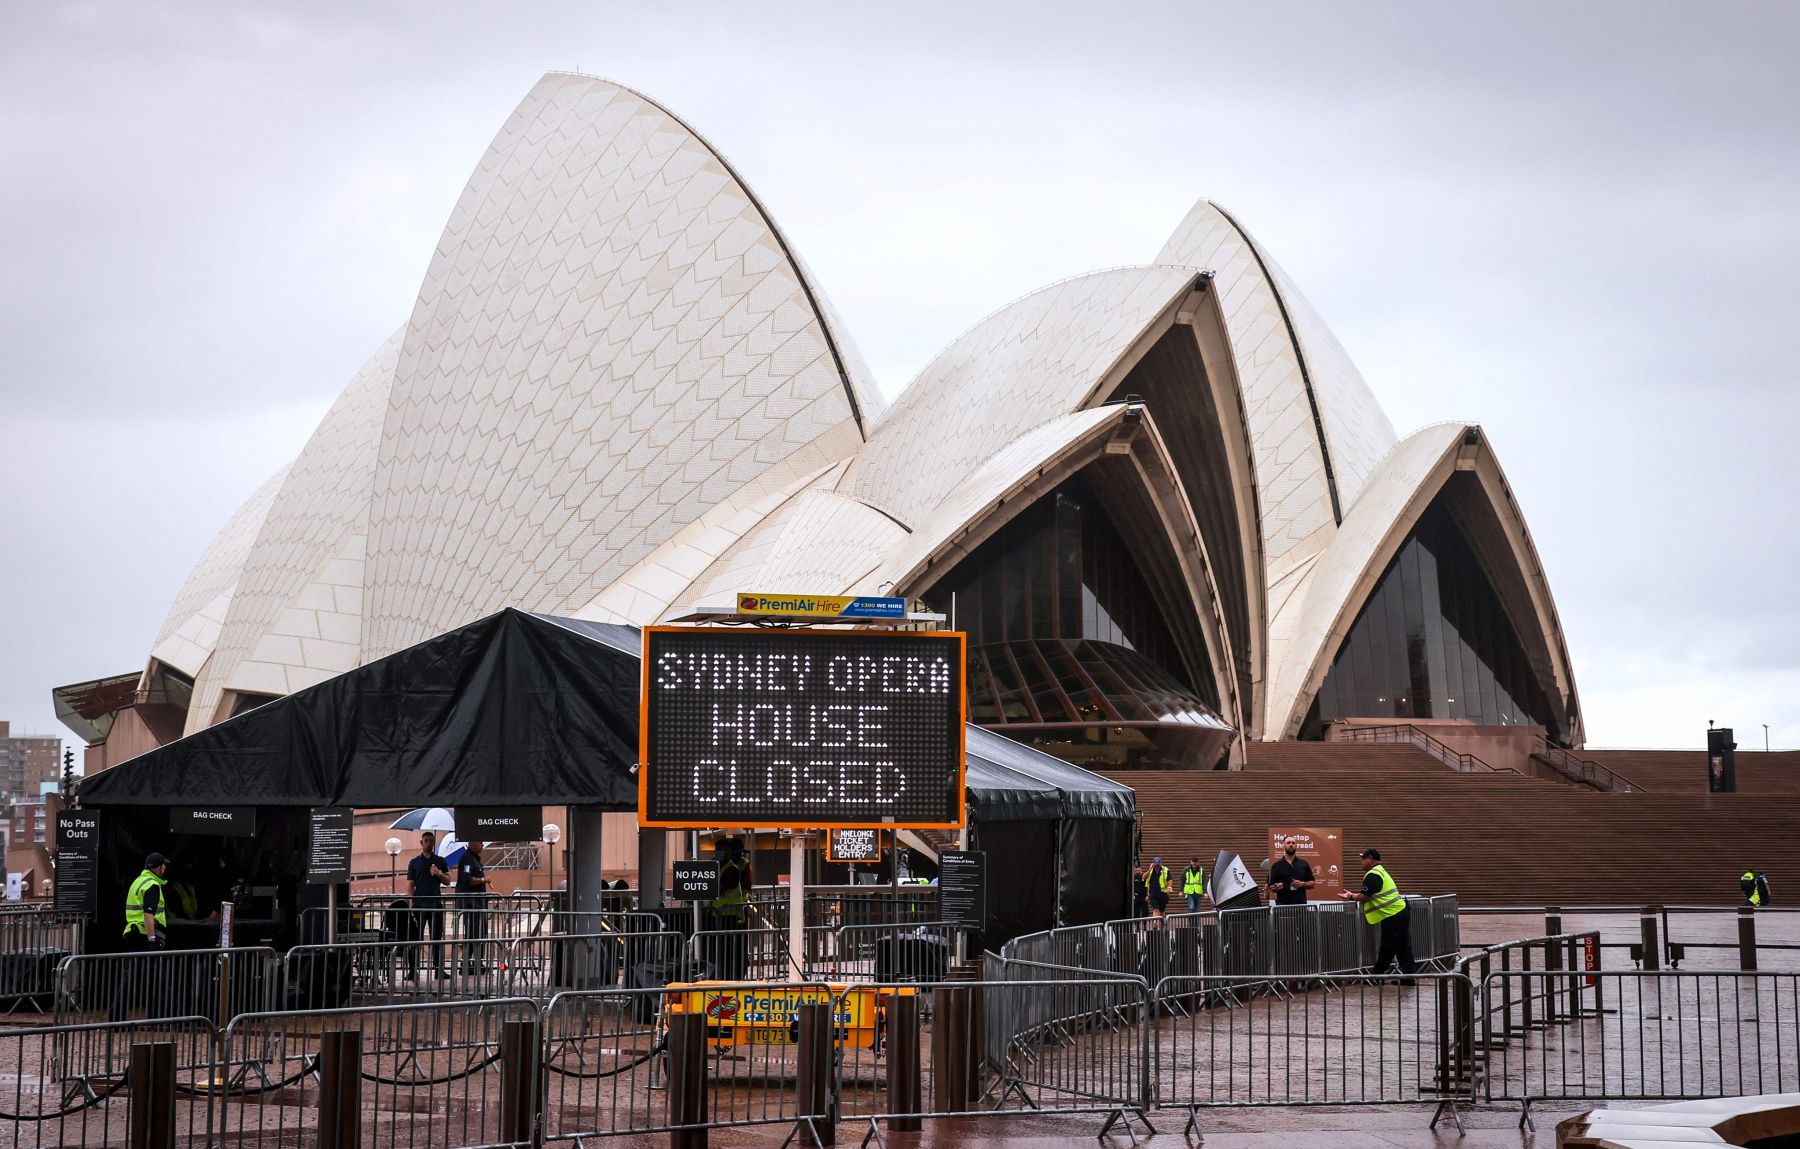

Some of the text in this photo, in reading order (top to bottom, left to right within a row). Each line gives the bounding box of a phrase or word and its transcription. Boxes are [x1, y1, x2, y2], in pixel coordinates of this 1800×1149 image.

[759, 598, 840, 612] PremiAir Hire
[658, 652, 949, 693] SYDNEY OPERA
[712, 703, 889, 746] HOUSE
[693, 758, 906, 803] CLOSED
[209, 812, 232, 820] CHECK
[66, 830, 88, 838] Outs
[676, 870, 716, 879] NO PASS
[683, 882, 708, 891] OUTS
[1585, 936, 1594, 970] STOP
[761, 1013, 790, 1021] 1300
